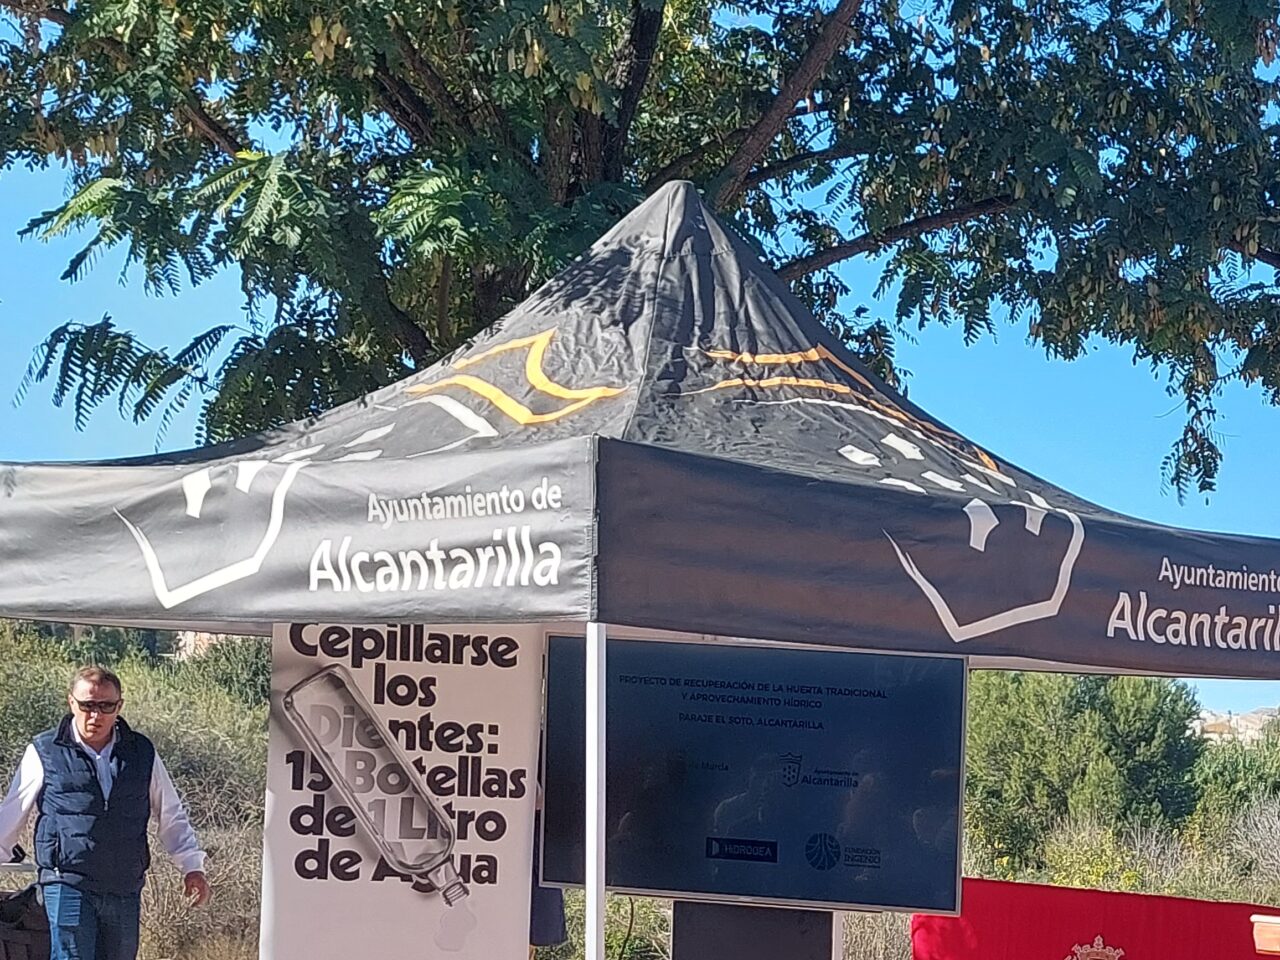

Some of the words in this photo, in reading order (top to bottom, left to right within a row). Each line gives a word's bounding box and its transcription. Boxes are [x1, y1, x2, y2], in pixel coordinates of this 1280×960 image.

[367, 486, 524, 524] Ayuntamiento
[530, 477, 562, 510] de
[309, 525, 562, 592] Alcantarilla
[289, 623, 519, 668] Cepillarse
[374, 663, 436, 707] los
[619, 675, 667, 686] PROYECTO
[669, 677, 681, 686] DE
[683, 678, 754, 691] RECUPERACIÓN
[757, 682, 770, 692] DE
[772, 683, 783, 693] LA
[786, 684, 823, 696] HUERTA
[826, 686, 887, 699] TRADICIONAL
[681, 692, 688, 700] Y
[690, 692, 781, 706] APROVECHAMIENTO
[310, 704, 499, 754] Dientes:
[679, 712, 712, 724] PARAJE
[715, 714, 725, 724] EL
[756, 717, 824, 730] ALCANTARILLA
[286, 750, 333, 792] 15
[801, 774, 859, 788] Alcantarilla
[289, 794, 357, 837] de
[294, 839, 362, 881] de
